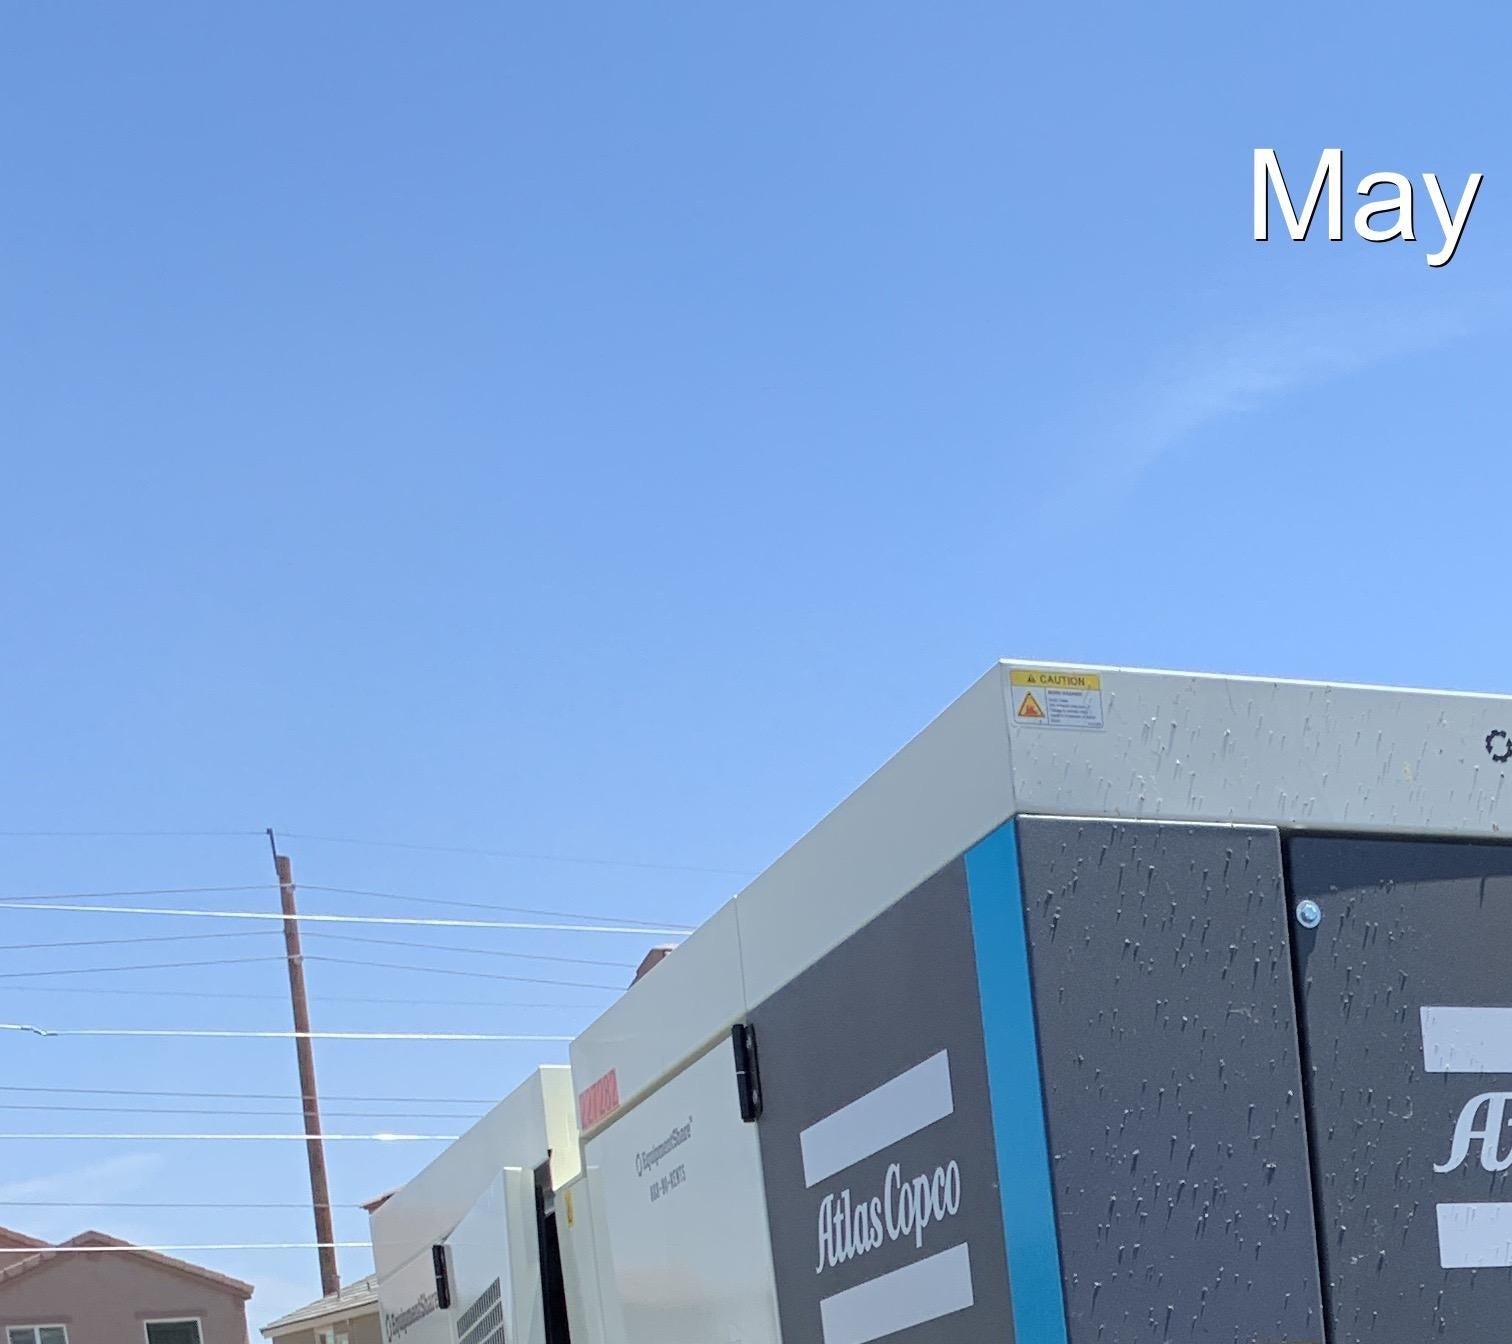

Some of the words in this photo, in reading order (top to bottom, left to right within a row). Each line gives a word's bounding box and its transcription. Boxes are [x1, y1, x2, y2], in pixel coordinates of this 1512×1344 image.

[1039, 674, 1085, 687] CAUTION
[815, 1188, 884, 1275] Atlas
[884, 1159, 961, 1249] Copco
